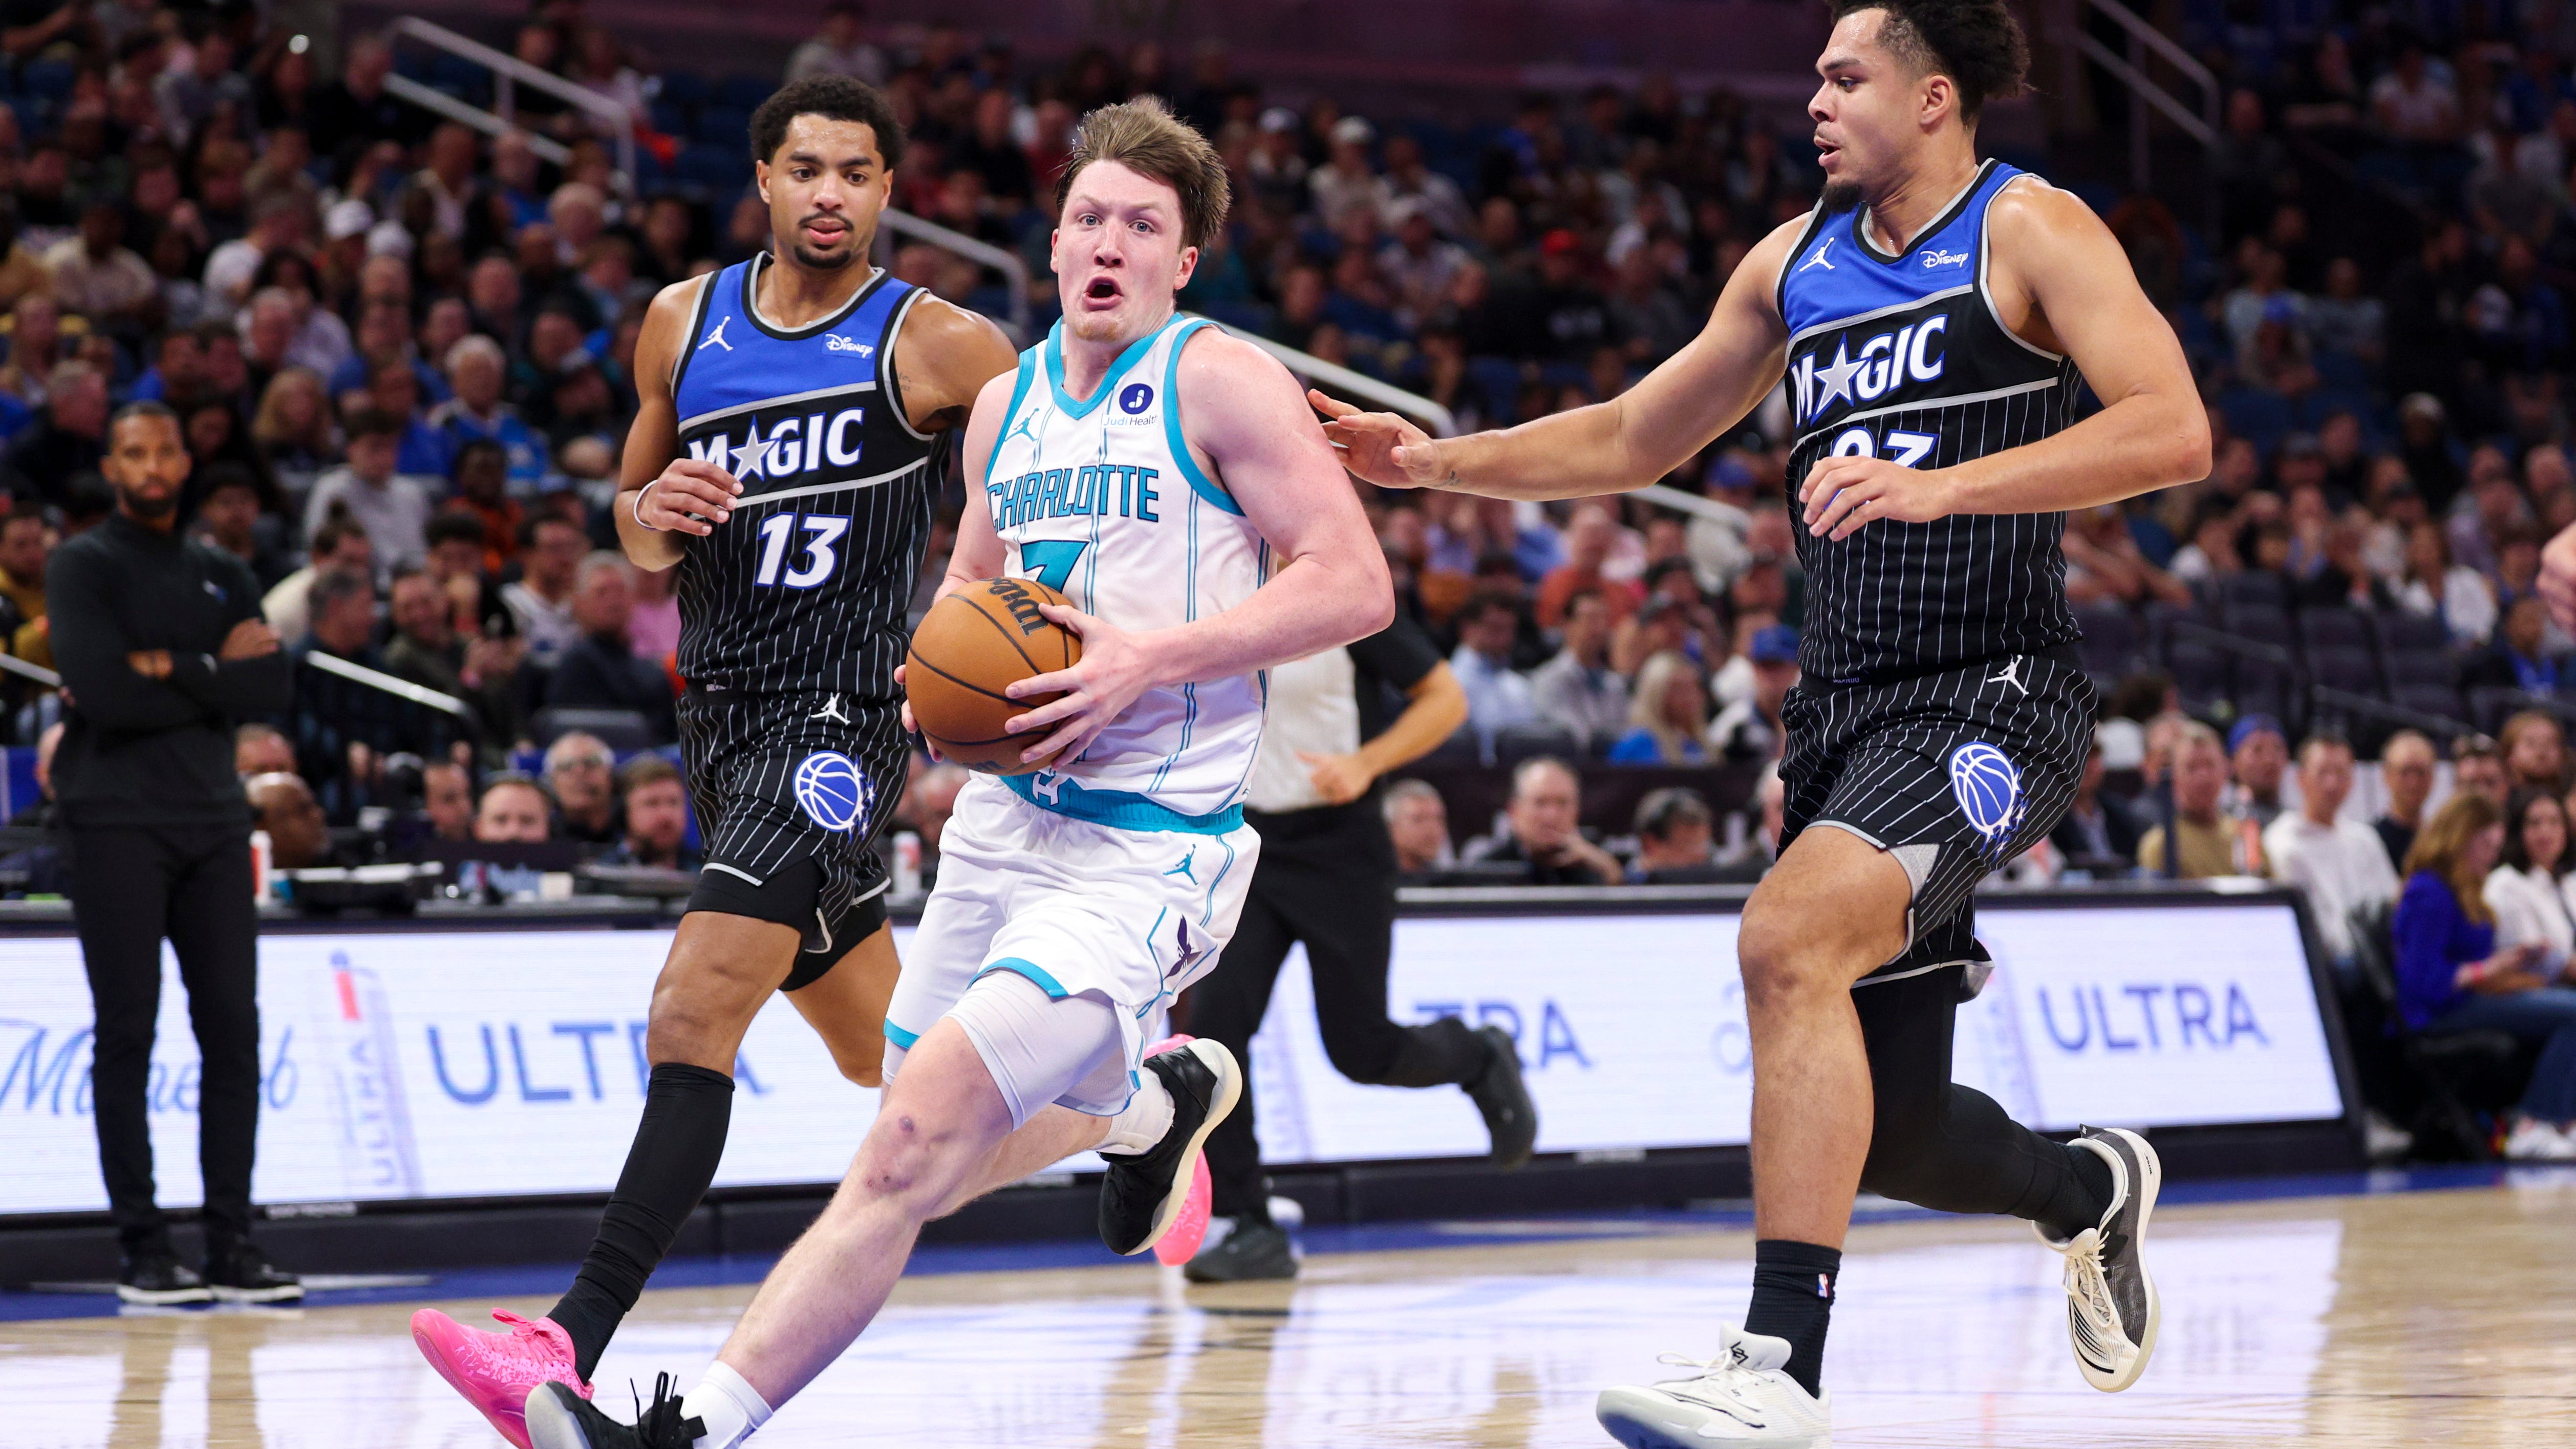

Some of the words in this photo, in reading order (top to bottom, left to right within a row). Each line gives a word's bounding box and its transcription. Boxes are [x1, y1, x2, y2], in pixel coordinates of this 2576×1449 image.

[1103, 417, 1128, 426] Judi
[987, 464, 1159, 534] CHARLOTTE
[754, 512, 852, 590] 13
[2037, 985, 2269, 1052] ULTRA
